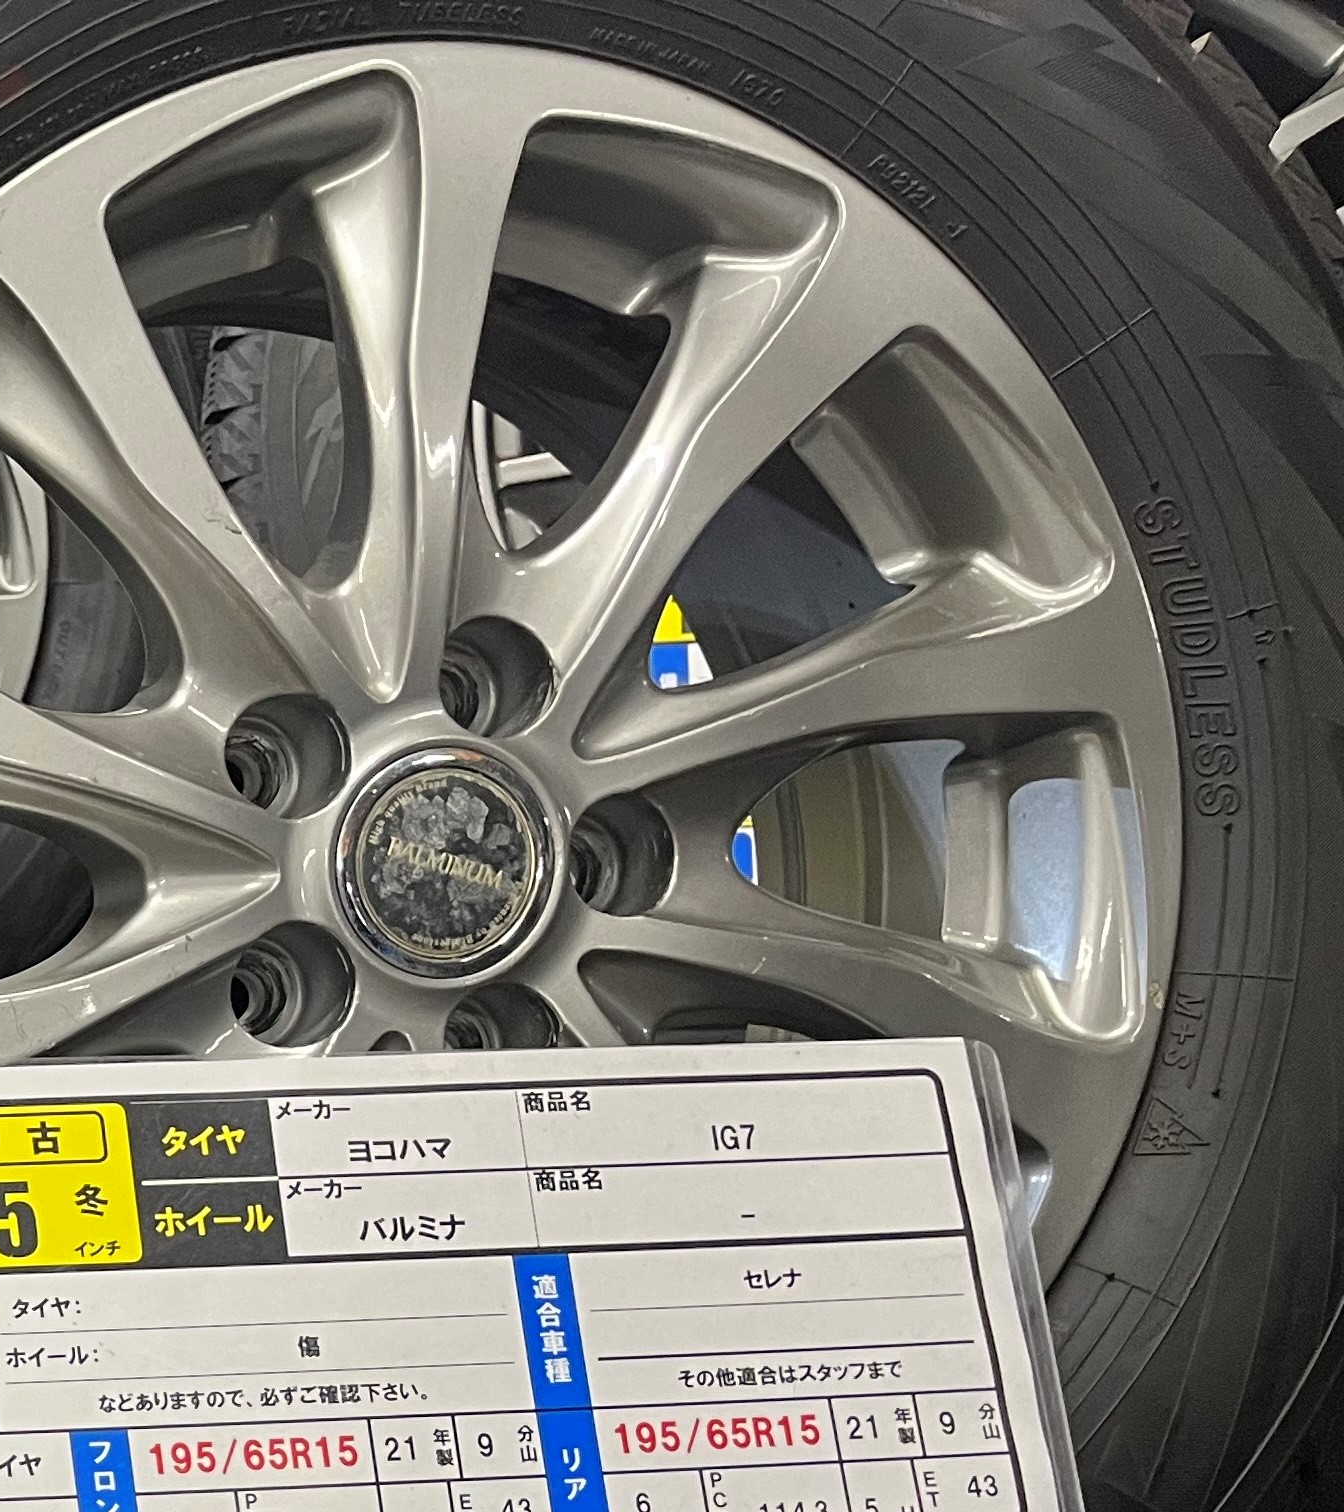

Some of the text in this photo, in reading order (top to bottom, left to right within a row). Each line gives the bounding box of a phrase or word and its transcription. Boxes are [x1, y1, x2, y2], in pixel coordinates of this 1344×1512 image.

[1132, 494, 1240, 819] STUDLESS
[387, 836, 505, 890] BALMINUM
[275, 1100, 351, 1121] メーカー
[522, 1089, 592, 1113] 商品名
[160, 1123, 246, 1159] タイヤ
[347, 1135, 453, 1163] ヨコハマ
[710, 1123, 755, 1151] IG7
[286, 1178, 363, 1199] メーカー
[533, 1168, 603, 1192] 商品名
[73, 1184, 108, 1217] 冬
[153, 1202, 274, 1237] ホイール
[359, 1214, 466, 1243] バルミナ
[72, 1239, 121, 1258] インチ
[742, 1266, 802, 1289] セレナ
[10, 1296, 82, 1319] タイヤ:
[529, 1272, 573, 1385] 適合車種
[4, 1346, 100, 1367] ホイール:
[296, 1335, 321, 1359] 傷
[676, 1359, 902, 1388] その他適合はスタッフまで
[97, 1381, 431, 1413] などありますので、必ずご確認下さい。
[613, 1413, 879, 1455] 195/65R15 21
[937, 1410, 957, 1436] 9
[147, 1433, 417, 1477] 195/65R15 21
[477, 1432, 495, 1458] 9
[560, 1446, 587, 1501] リア
[966, 1473, 999, 1499] 43
